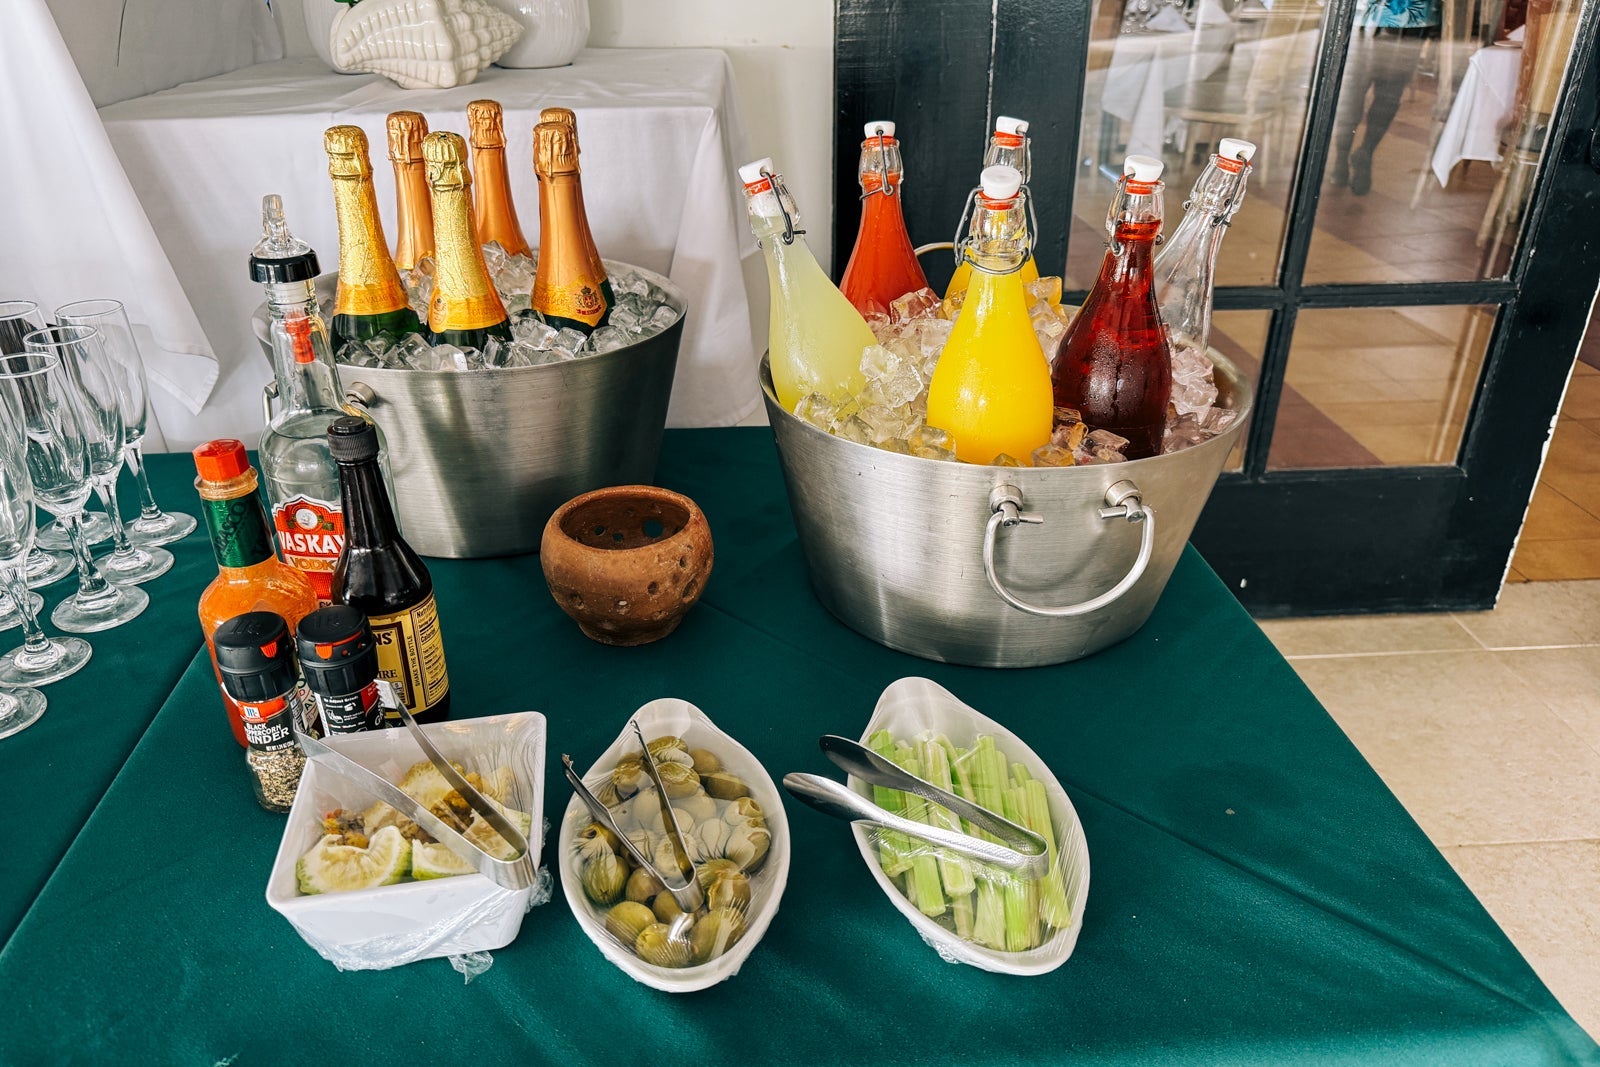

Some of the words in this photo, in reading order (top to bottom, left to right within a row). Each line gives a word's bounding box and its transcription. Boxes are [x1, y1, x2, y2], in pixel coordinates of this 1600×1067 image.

[289, 557, 337, 570] VODK
[244, 724, 282, 737] PPERCORN
[246, 722, 267, 731] BLACK
